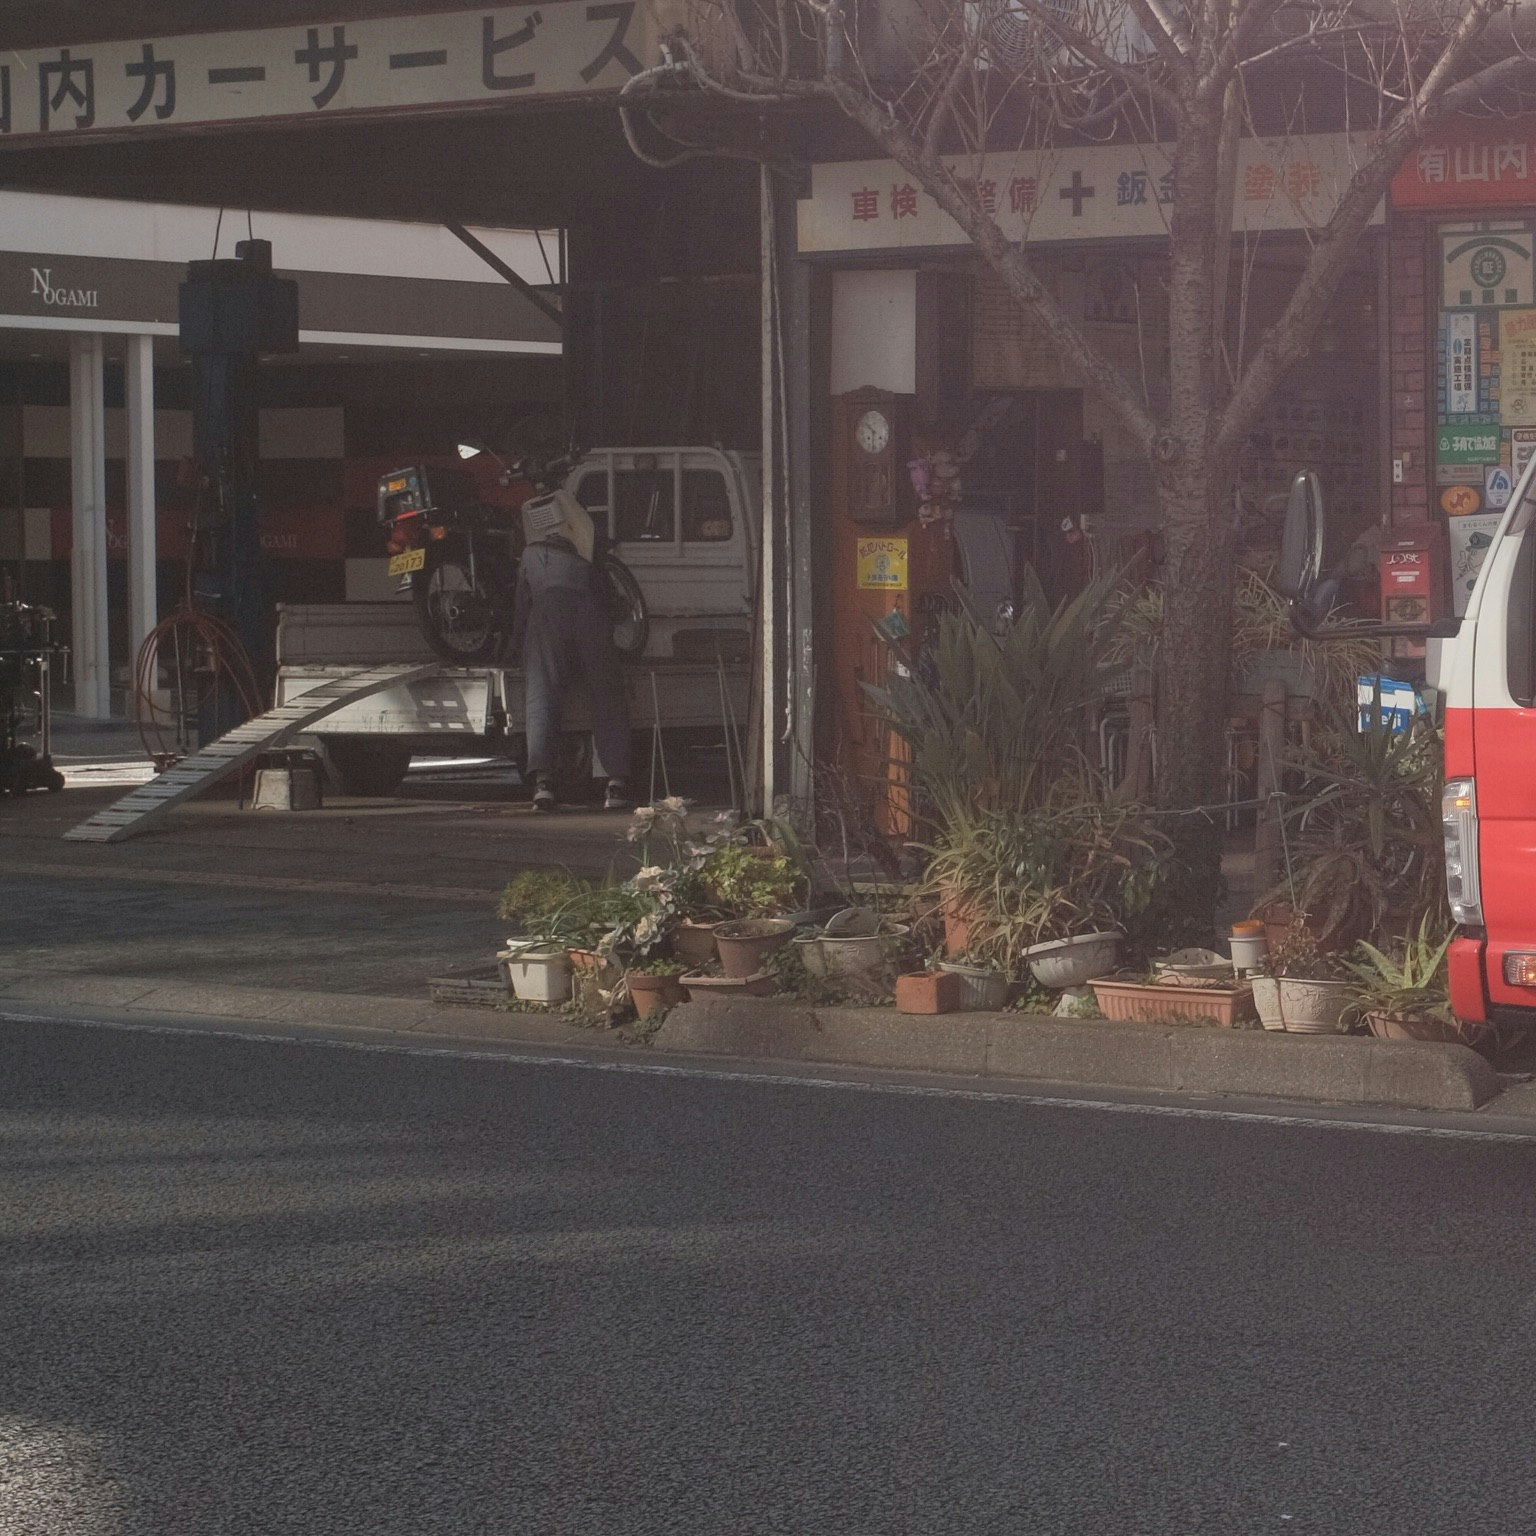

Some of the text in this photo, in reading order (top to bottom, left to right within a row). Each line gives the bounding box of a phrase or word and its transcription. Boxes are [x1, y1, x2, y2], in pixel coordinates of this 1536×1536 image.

[0, 1, 645, 133] 内カーサービス
[852, 183, 917, 221] 車検
[30, 267, 99, 307] NOGAMI
